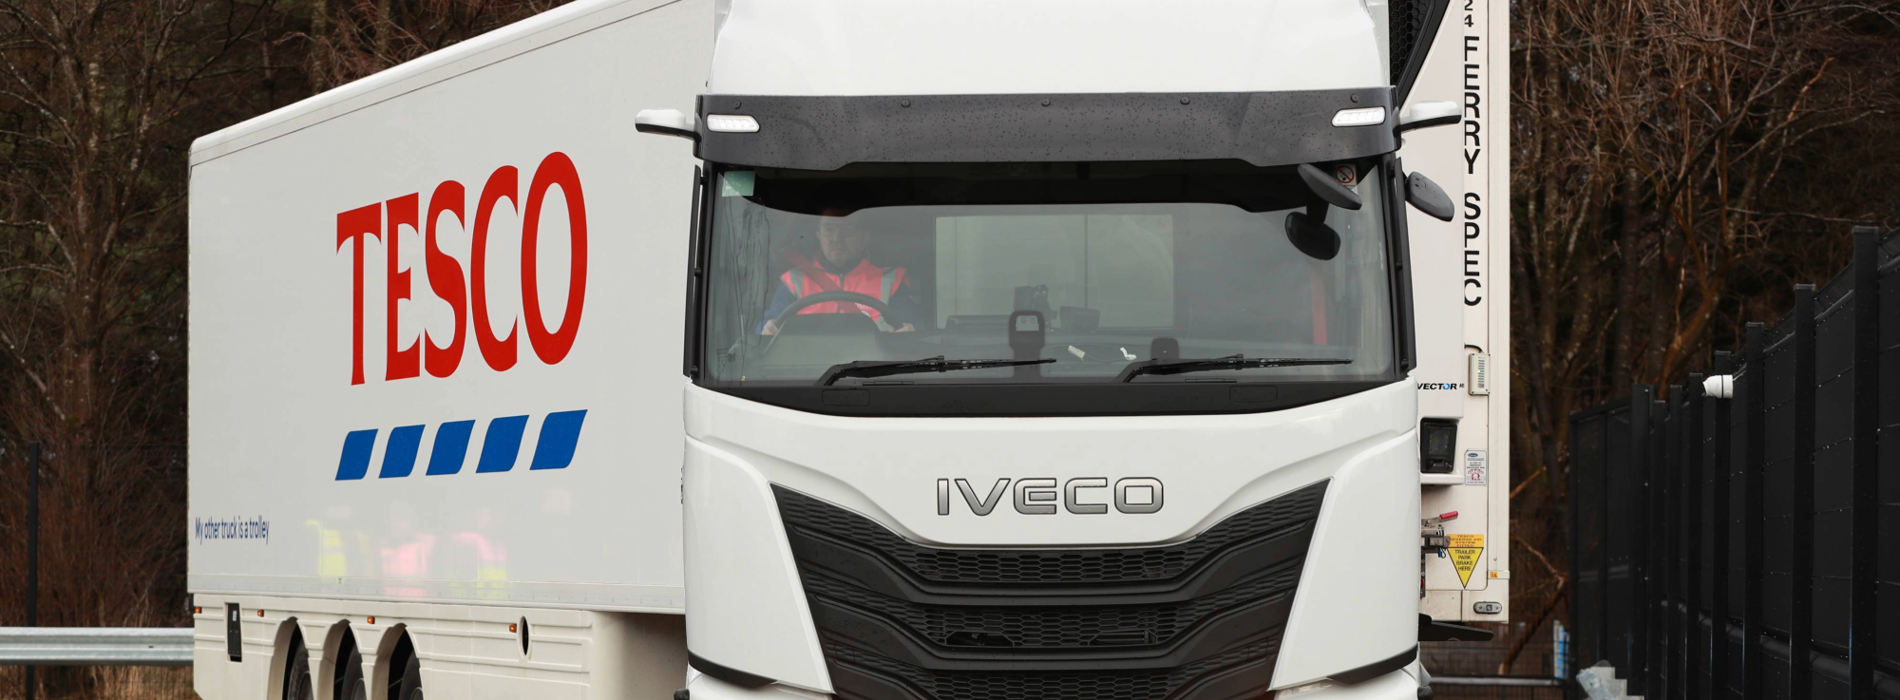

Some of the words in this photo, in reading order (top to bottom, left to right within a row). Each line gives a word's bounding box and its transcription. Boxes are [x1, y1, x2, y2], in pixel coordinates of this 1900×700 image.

[1464, 36, 1481, 174] FERRY
[336, 151, 588, 386] TESCO
[1464, 192, 1482, 307] SPEC
[1417, 382, 1457, 390] VECTOR
[195, 516, 203, 545] My
[204, 516, 220, 539] other
[221, 516, 237, 539] truck
[238, 515, 243, 539] is
[244, 521, 248, 539] a
[249, 515, 269, 545] trolley
[936, 476, 1164, 516] IVECO
